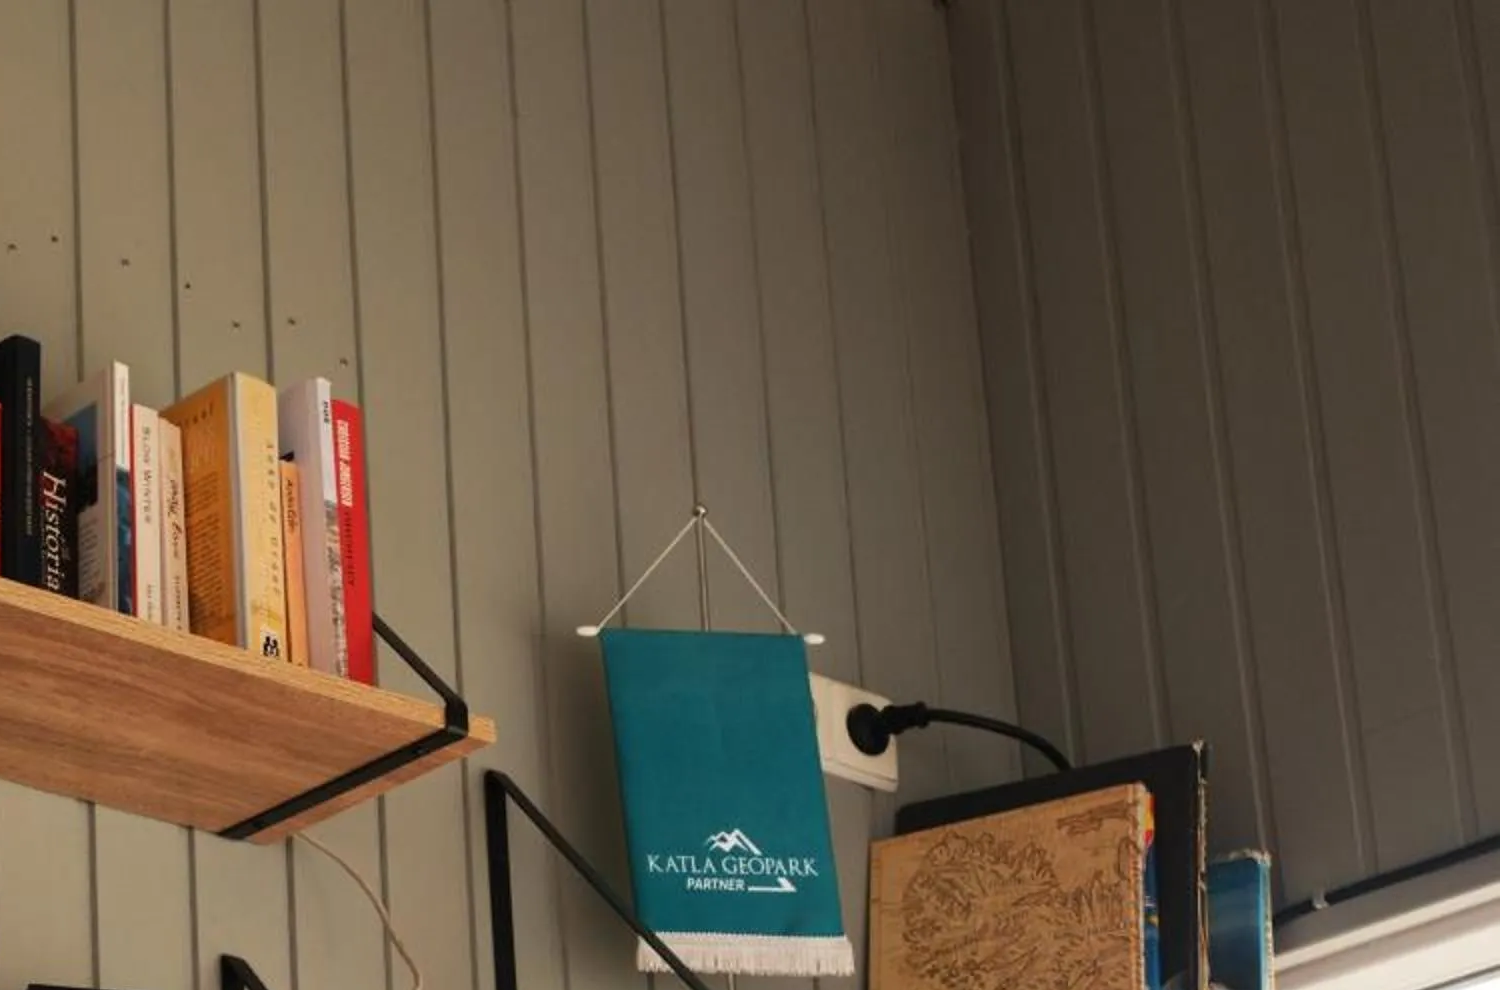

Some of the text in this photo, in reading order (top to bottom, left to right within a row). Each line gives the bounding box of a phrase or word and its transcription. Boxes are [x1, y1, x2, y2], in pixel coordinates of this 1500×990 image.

[43, 470, 68, 590] Historia
[647, 854, 819, 877] KATLA GEOPARK
[686, 876, 745, 891] PARTNER
